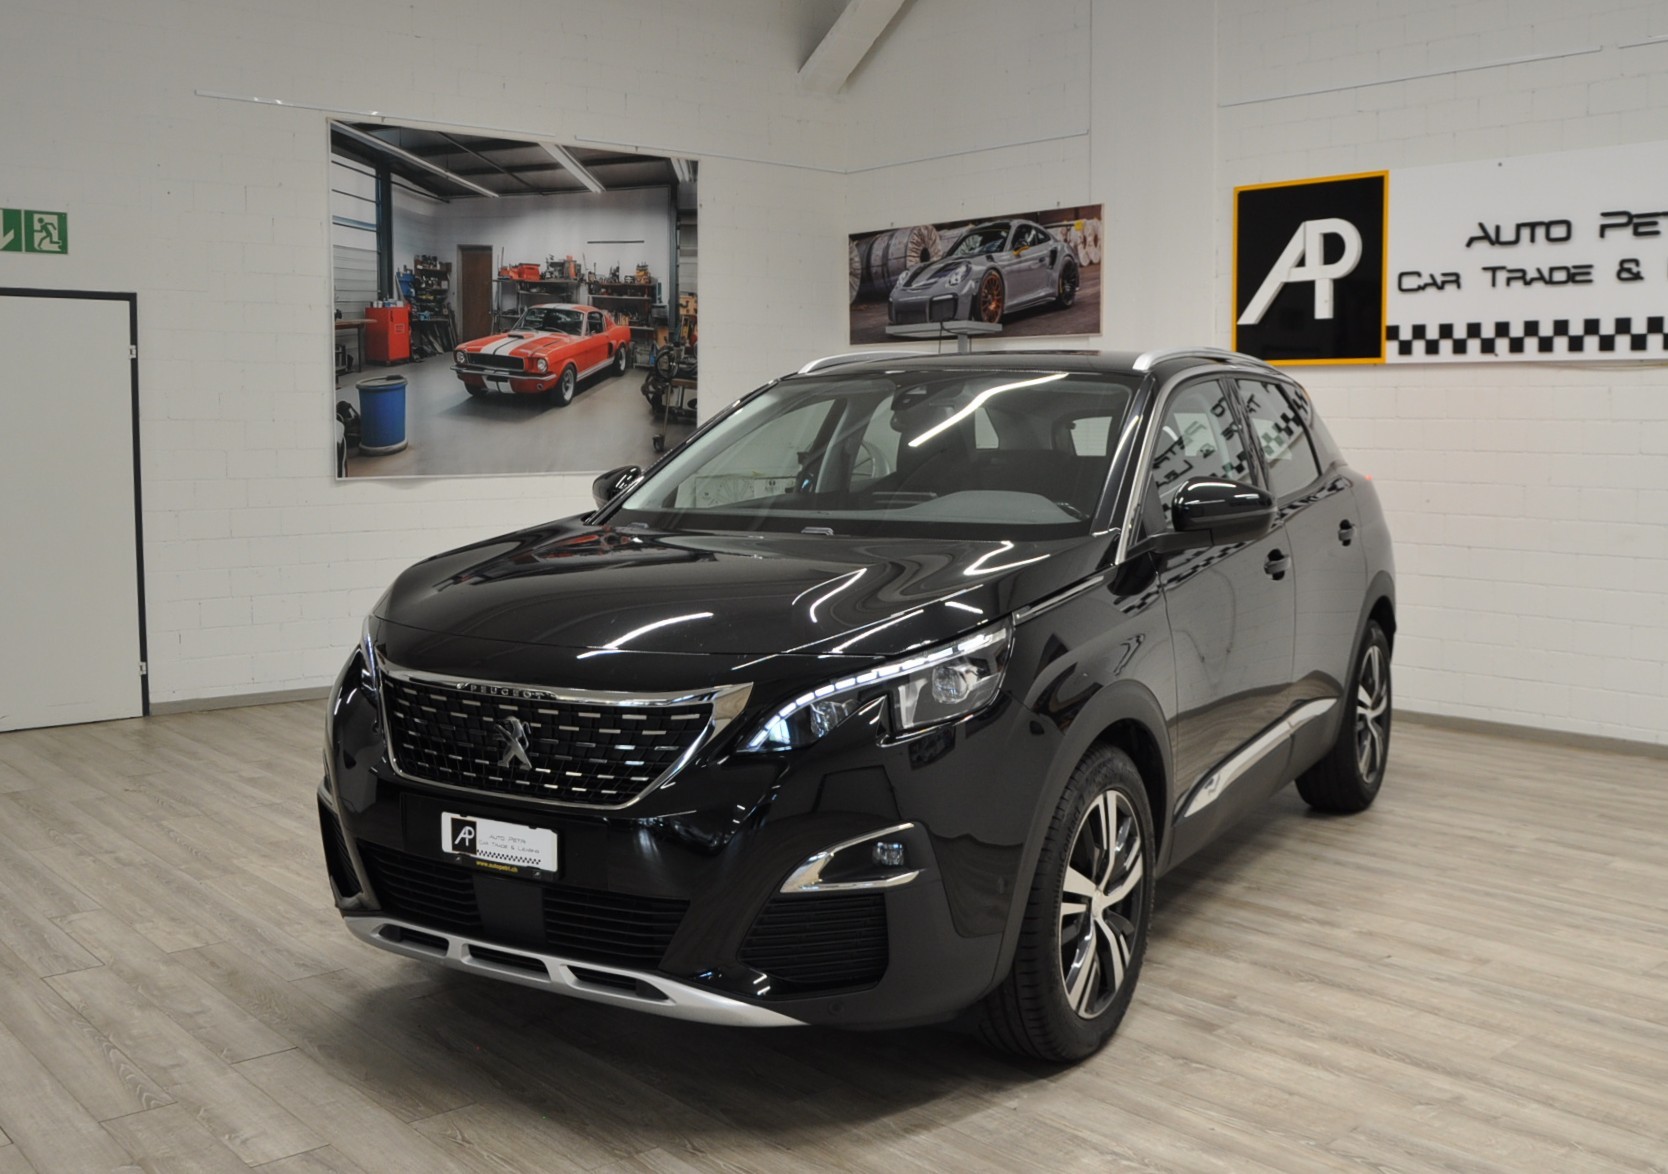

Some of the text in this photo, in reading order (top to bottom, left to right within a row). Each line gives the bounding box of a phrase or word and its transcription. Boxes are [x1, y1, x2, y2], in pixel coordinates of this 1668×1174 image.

[1466, 210, 1668, 248] AUTO PE
[1398, 271, 1462, 293] CAR
[1482, 265, 1594, 288] TRADE
[1616, 259, 1644, 282] &
[470, 684, 543, 699] PEUGEOT
